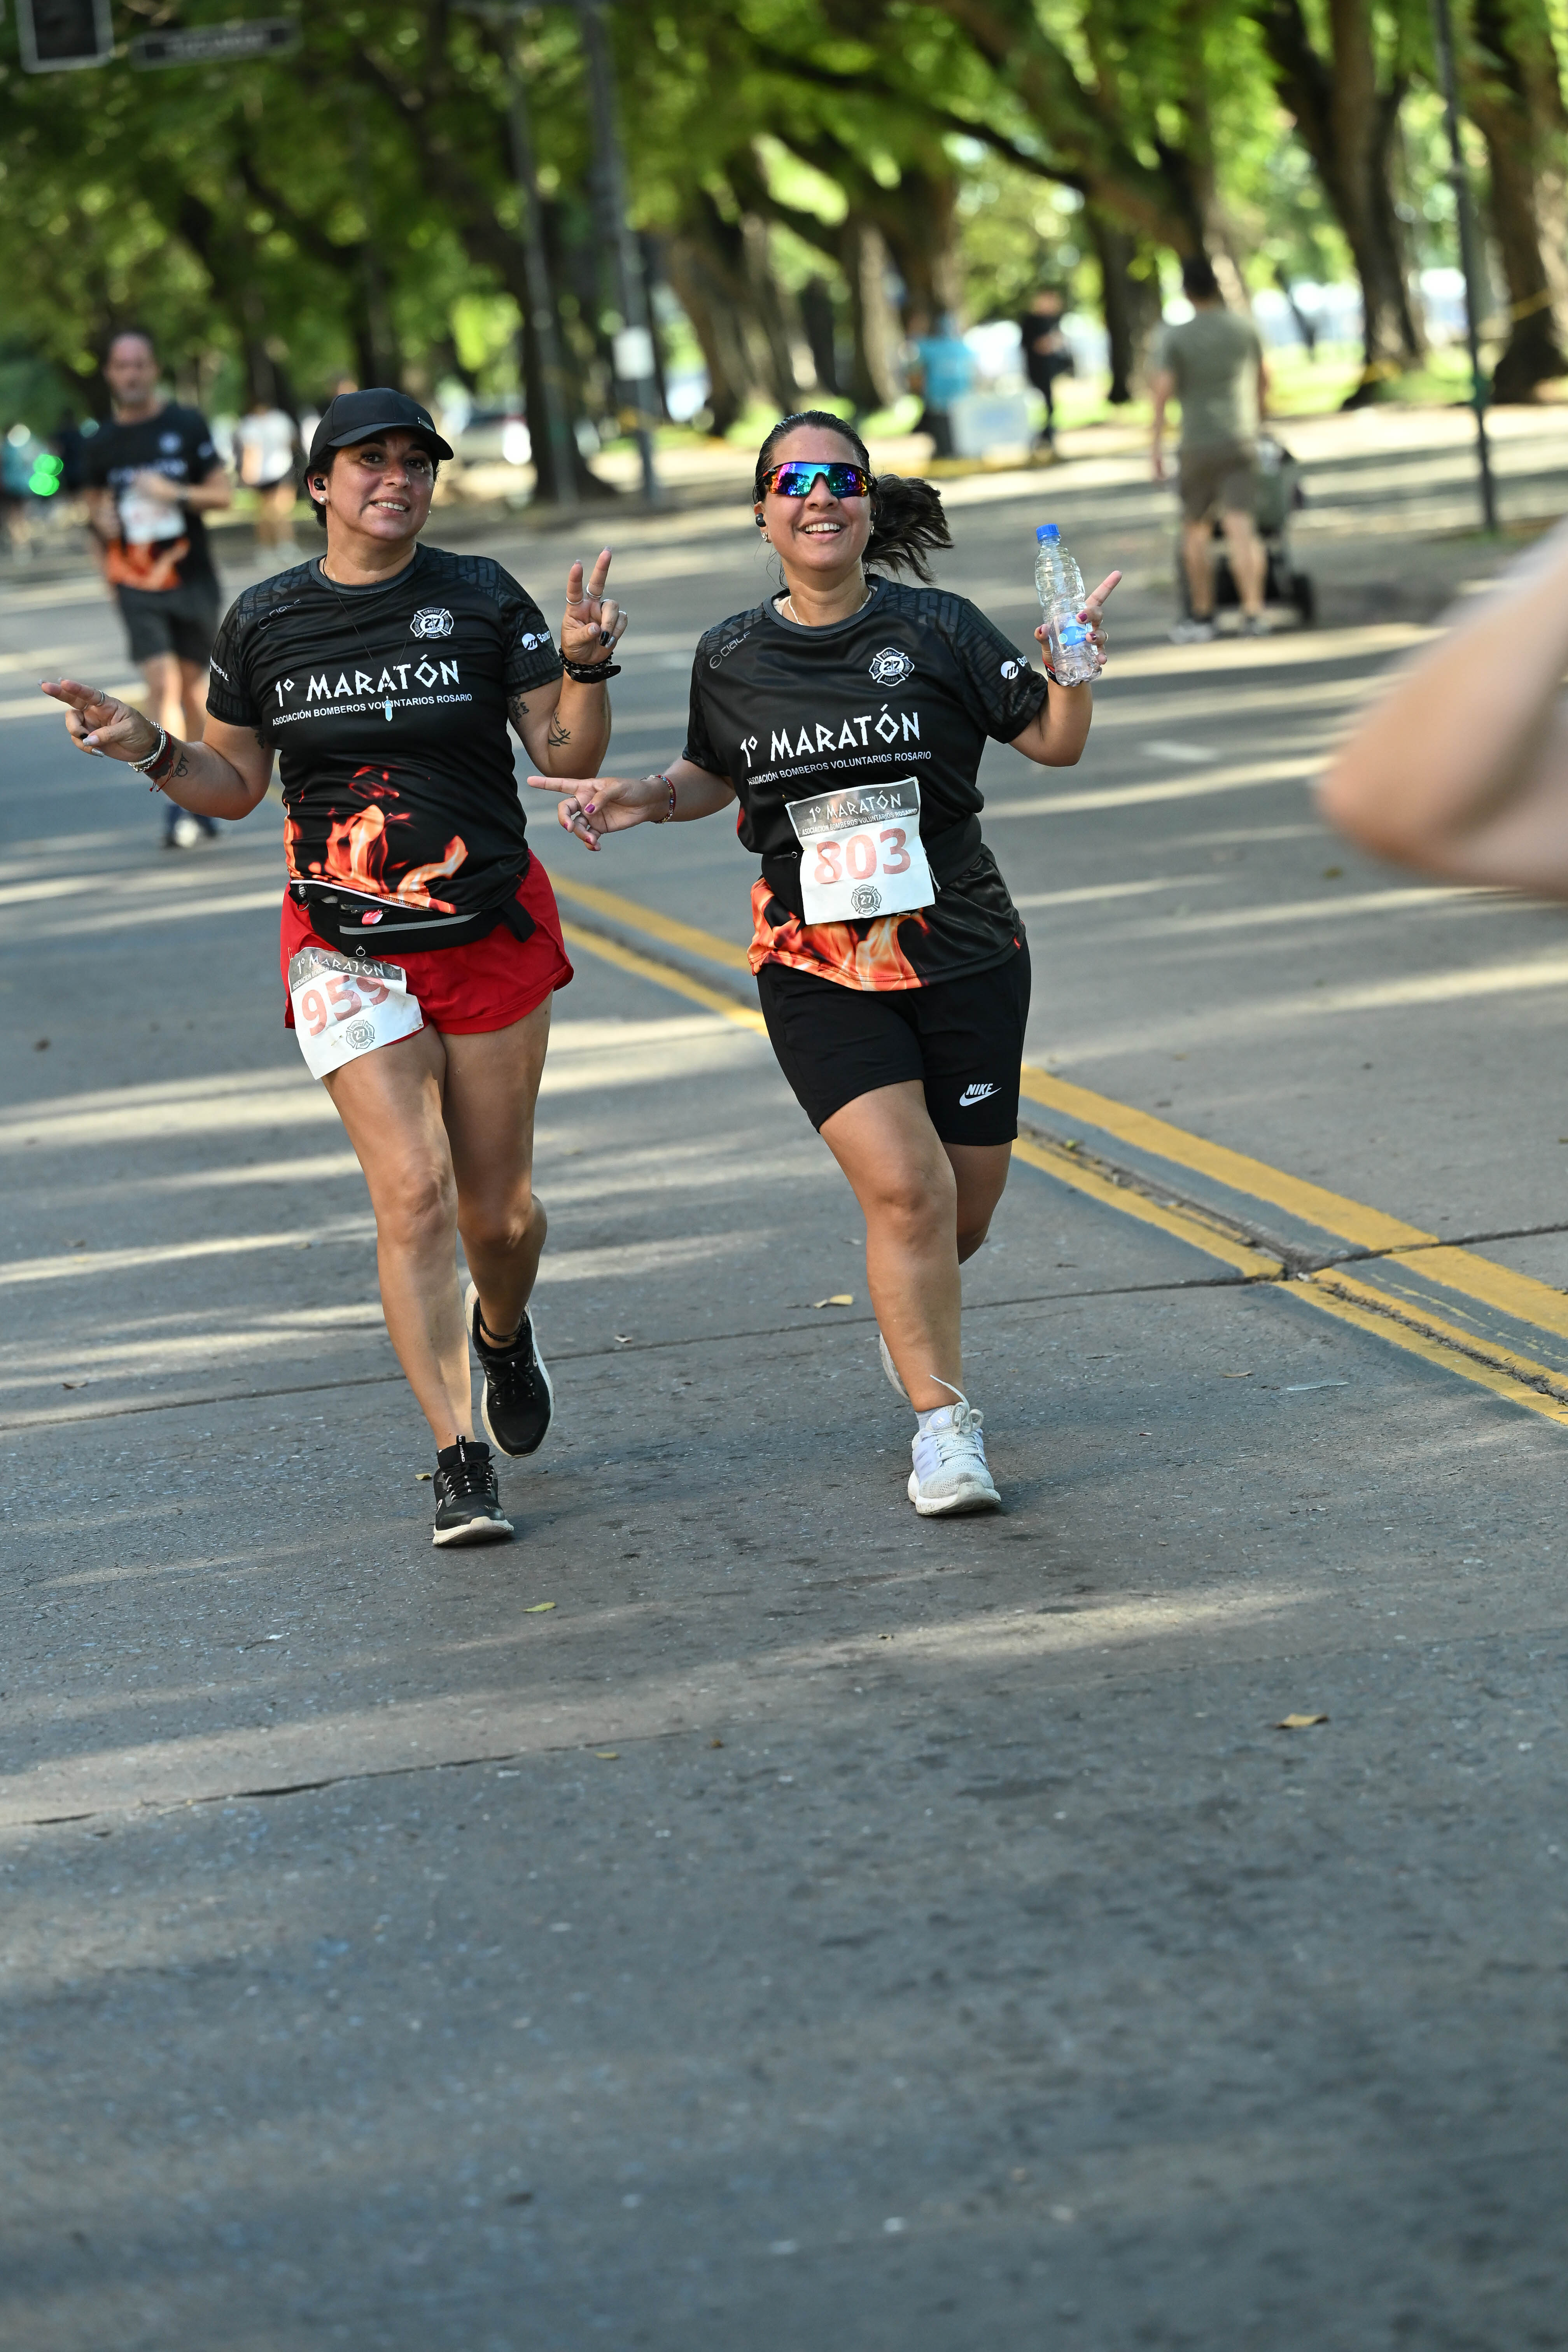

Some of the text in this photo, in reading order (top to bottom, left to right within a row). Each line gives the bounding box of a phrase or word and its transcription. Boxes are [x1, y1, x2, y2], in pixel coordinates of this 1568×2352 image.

[425, 618, 441, 629] 27
[306, 654, 460, 702] MARATÓN
[883, 661, 900, 670] 27
[273, 710, 312, 726] ASOCIACIÓN
[313, 704, 366, 717] BOMBEROS
[436, 694, 472, 704] ROSARIO
[770, 704, 920, 761] MARATÓN
[747, 751, 931, 786] ASOCIACIÓN BOMBEROS VOLUNTARIOS ROSARIO
[827, 790, 901, 820] MARATÓN
[802, 808, 917, 836] ASOCIACIÓN BOMBEROS VOLUNTARIOS ROSARIO
[814, 828, 911, 884] 803
[860, 894, 872, 905] 27
[309, 954, 385, 977] MARATÓN
[302, 974, 390, 1036] 959
[354, 1029, 365, 1040] 27
[966, 1083, 993, 1095] NIKE
